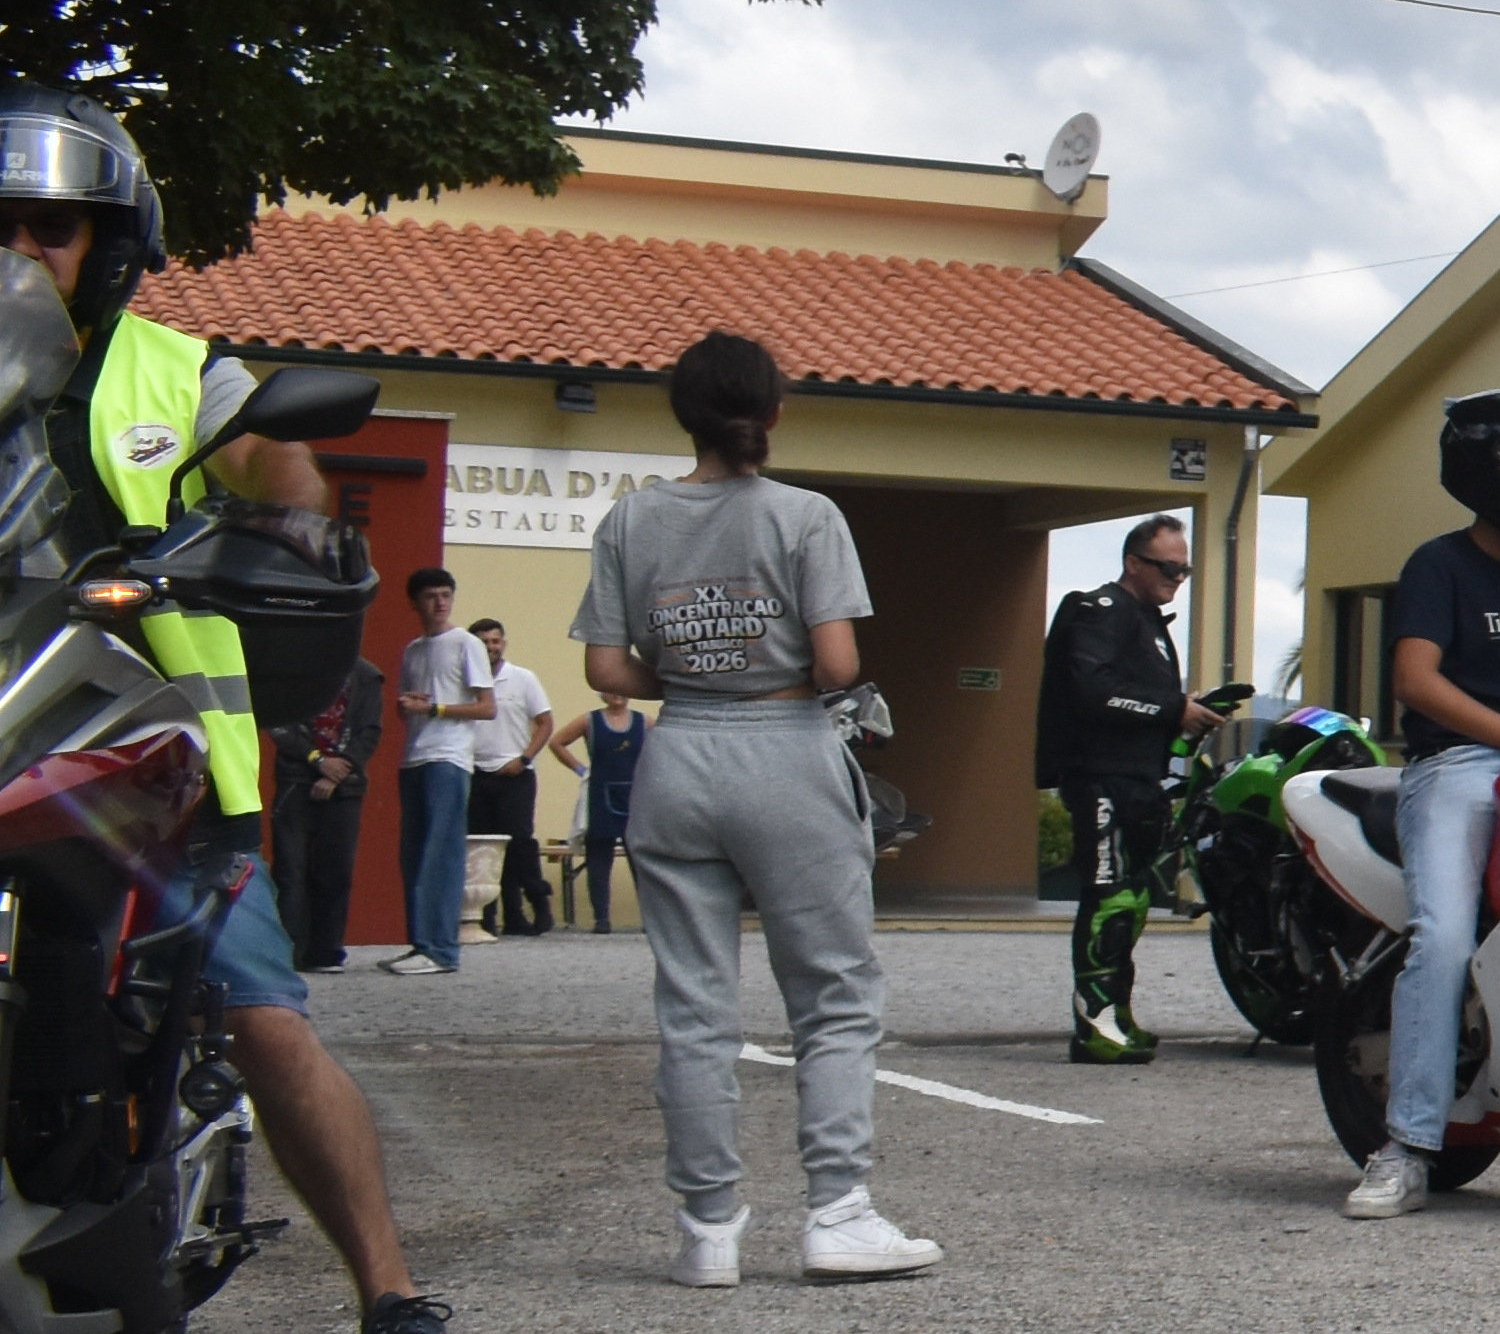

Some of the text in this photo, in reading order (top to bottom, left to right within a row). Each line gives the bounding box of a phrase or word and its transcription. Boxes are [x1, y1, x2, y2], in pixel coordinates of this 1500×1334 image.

[445, 464, 664, 500] ABUA D'A
[442, 508, 586, 534] ESTAUR
[693, 584, 728, 603] XX
[662, 616, 766, 646] MOTARD
[686, 650, 748, 673] 2026
